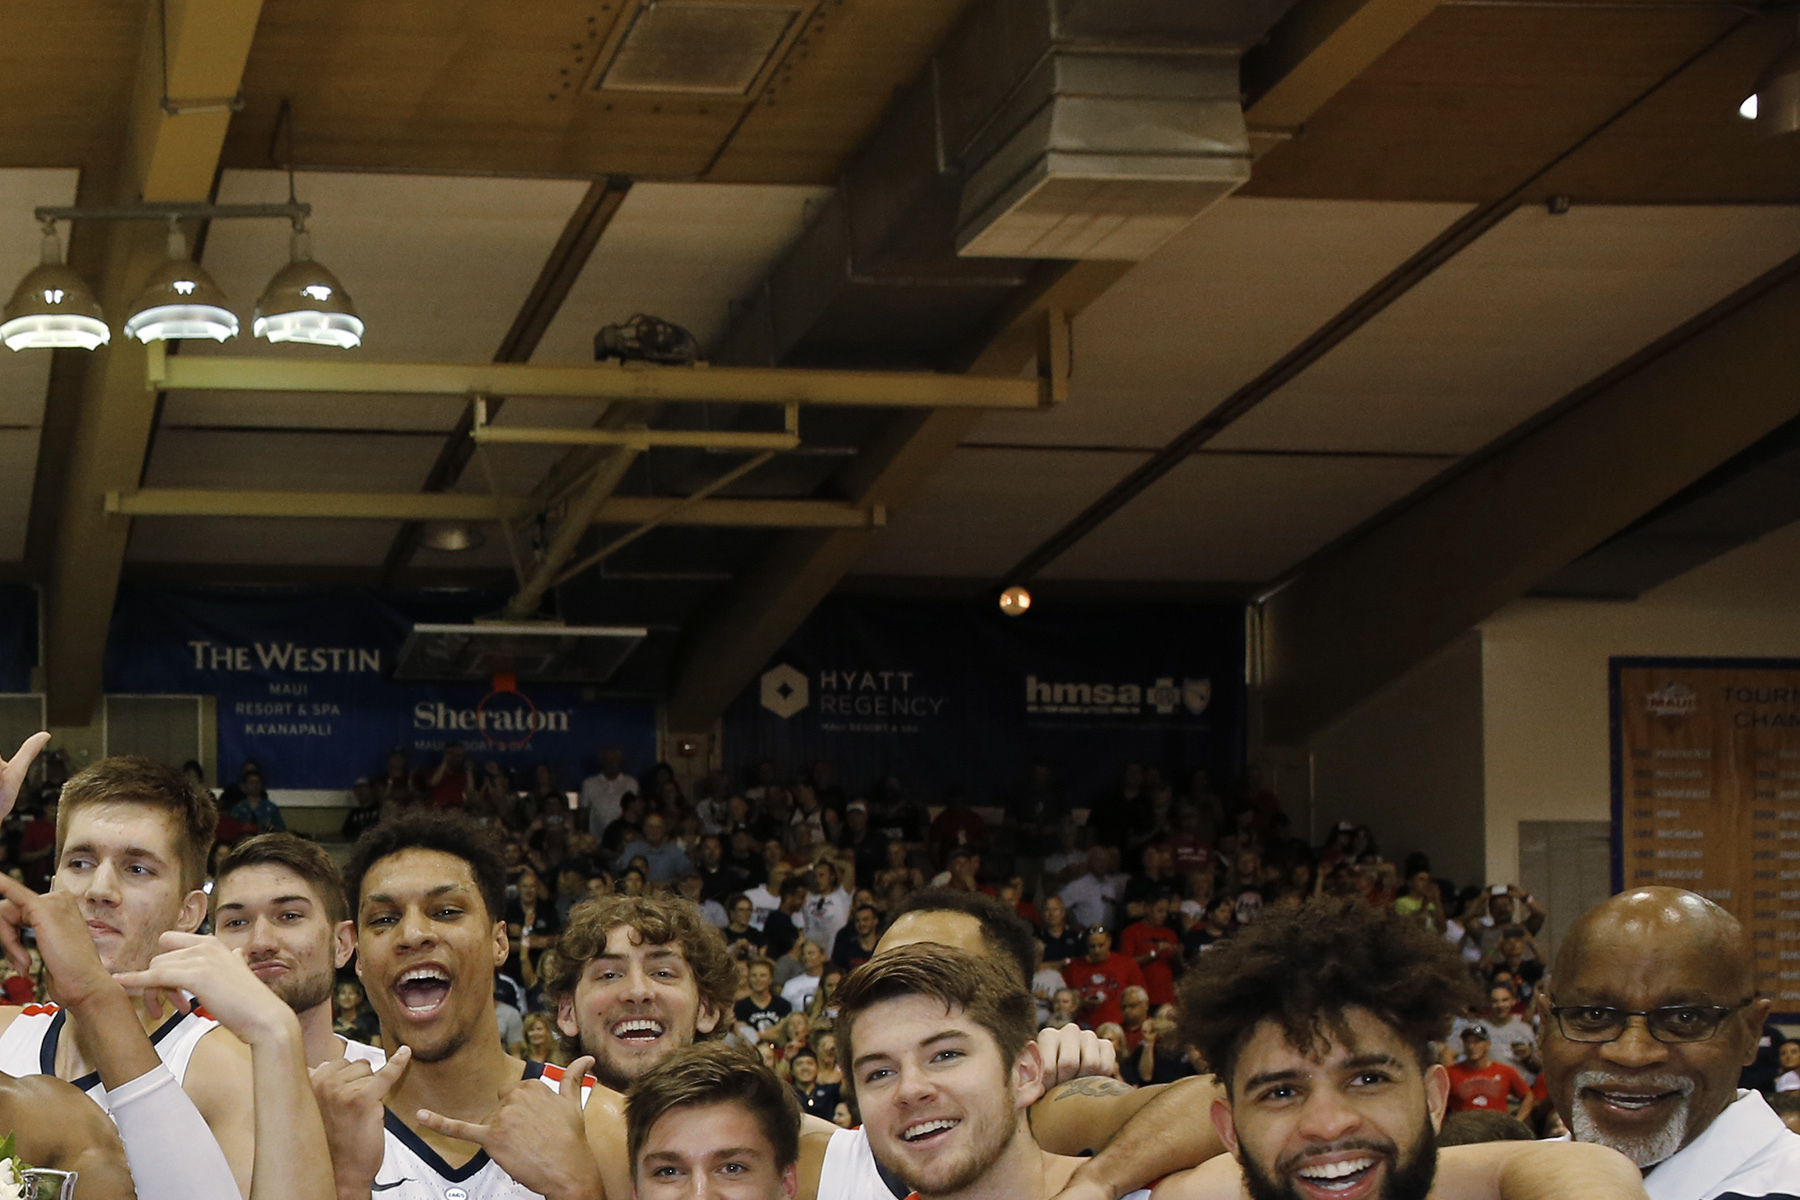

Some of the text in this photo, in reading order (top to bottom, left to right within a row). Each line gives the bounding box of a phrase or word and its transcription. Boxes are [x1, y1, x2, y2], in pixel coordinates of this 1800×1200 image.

[187, 640, 250, 671] THE
[254, 642, 381, 673] WESTIN
[268, 682, 308, 696] MAUI
[821, 670, 914, 691] HYATT
[1026, 675, 1141, 704] hmsa
[235, 702, 293, 716] RESORT
[312, 703, 341, 716] SPA
[821, 694, 943, 716] REGENCY
[413, 701, 570, 732] Sheraton
